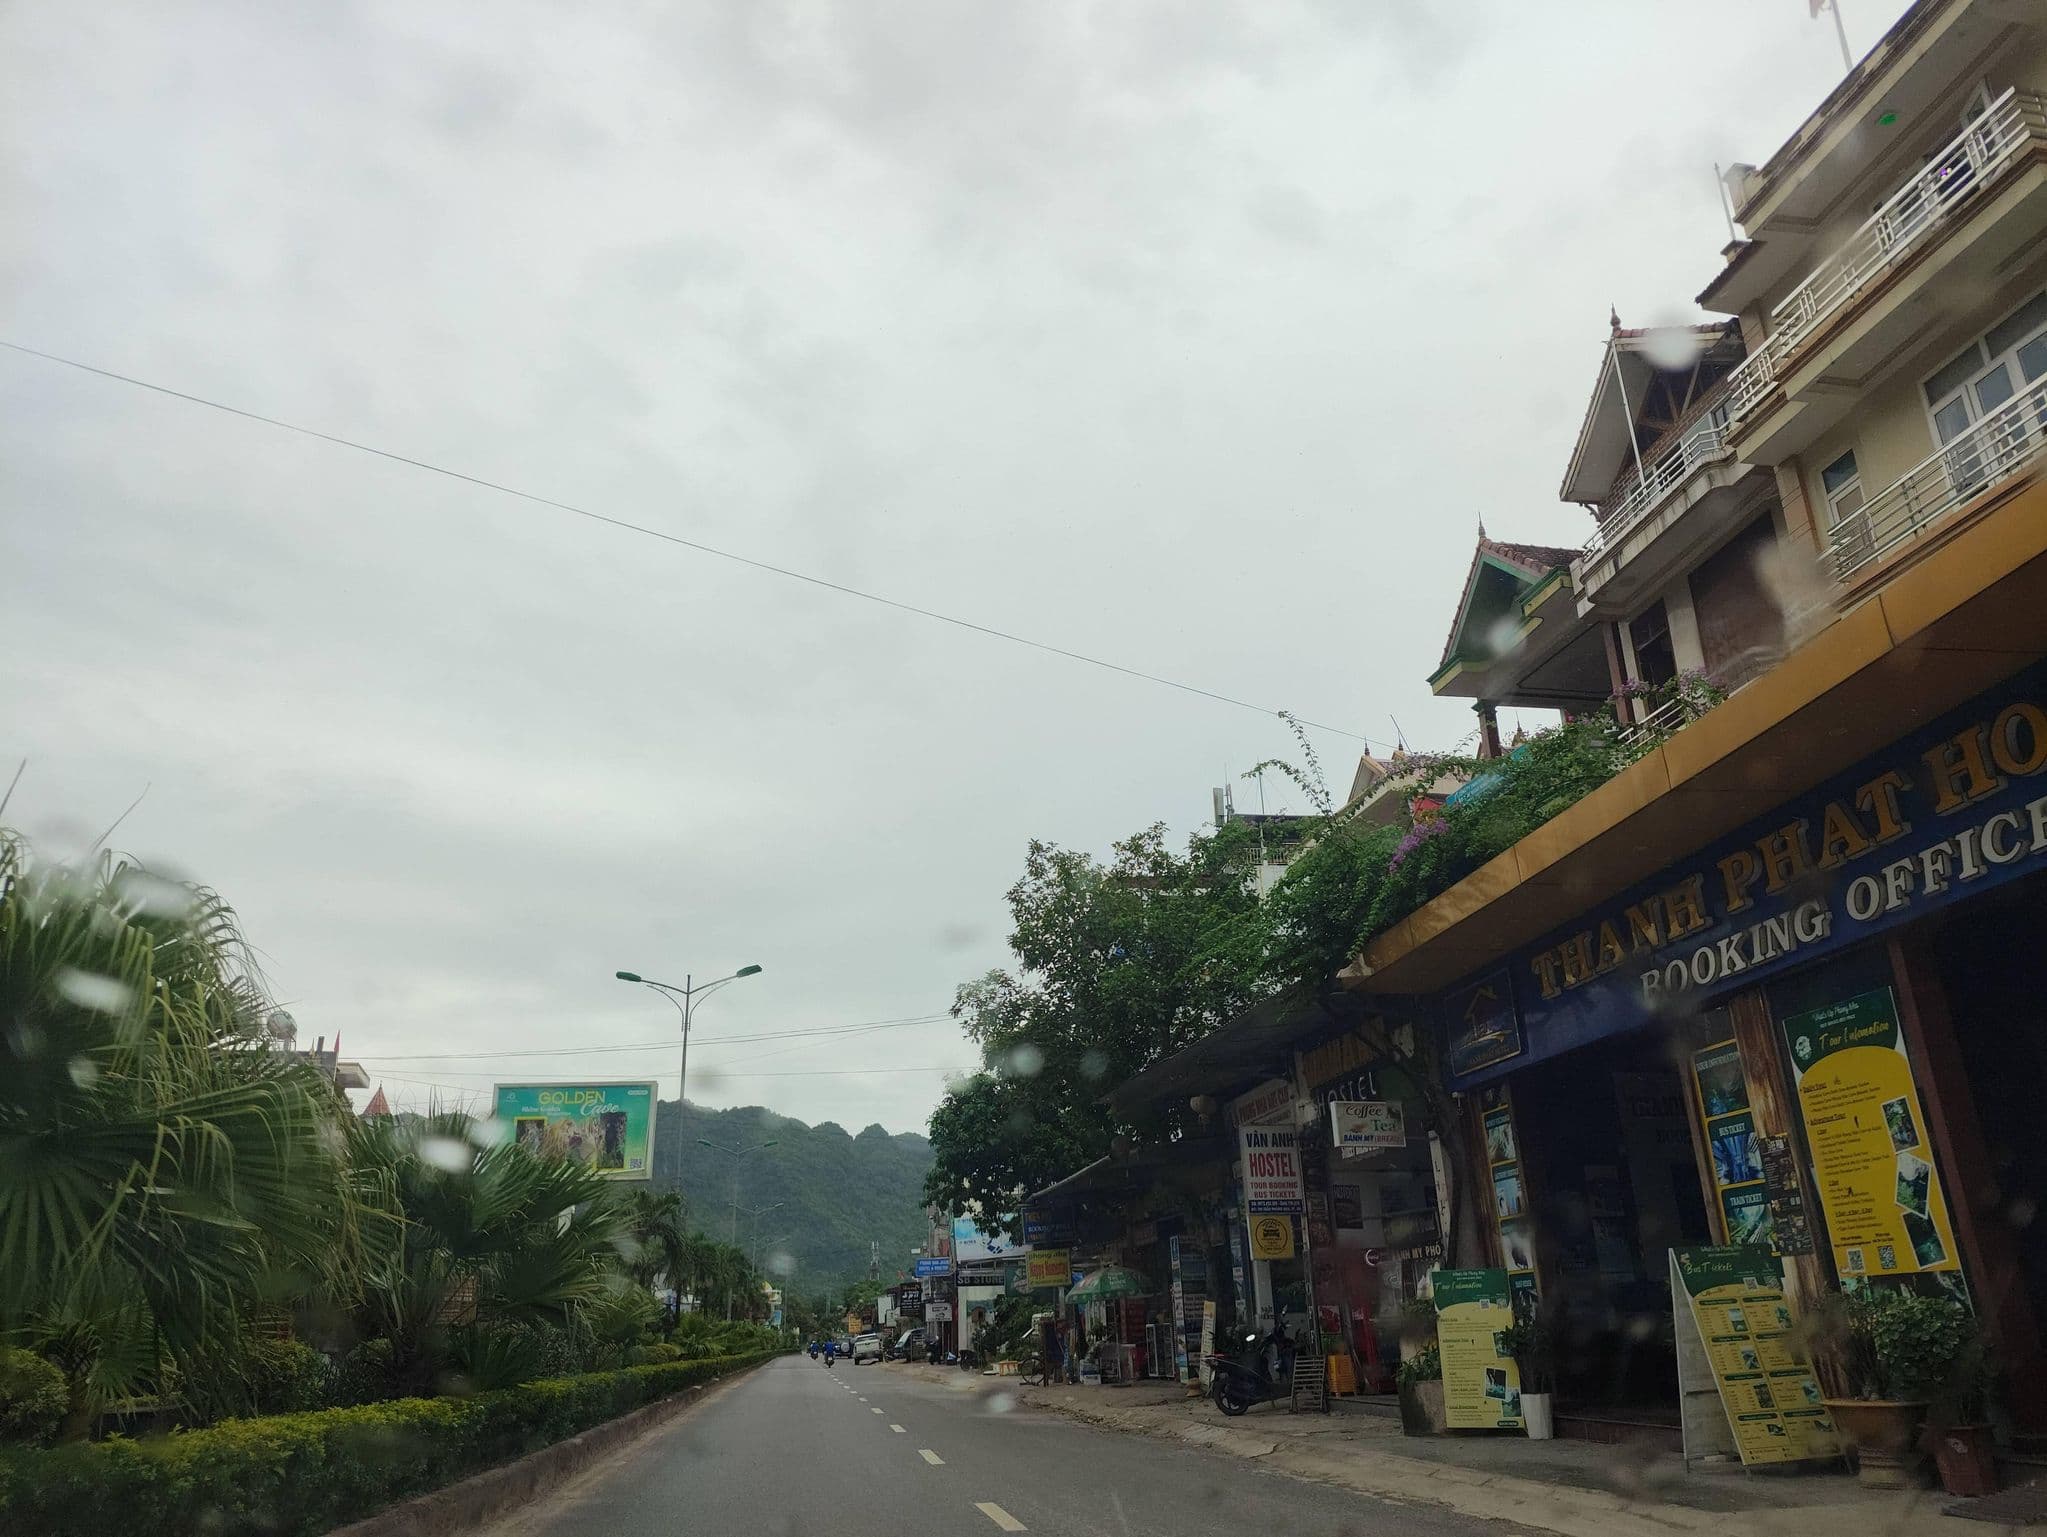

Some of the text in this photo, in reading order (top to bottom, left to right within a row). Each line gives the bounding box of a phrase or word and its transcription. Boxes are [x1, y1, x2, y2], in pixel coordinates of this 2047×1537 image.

[1531, 872, 1710, 1001] THANH
[1716, 769, 1914, 914] PHAT
[1639, 899, 1832, 1006] BOOKING
[538, 1090, 606, 1105] GOLDEN
[580, 1100, 620, 1116] Cave
[1345, 1104, 1383, 1119] Coffee
[1370, 1119, 1397, 1131] Tea
[1719, 1122, 1745, 1136] BUS TICKET
[1271, 1133, 1294, 1148] ANH
[1249, 1152, 1296, 1177] HOSTEL
[1683, 1262, 1701, 1275] Bus
